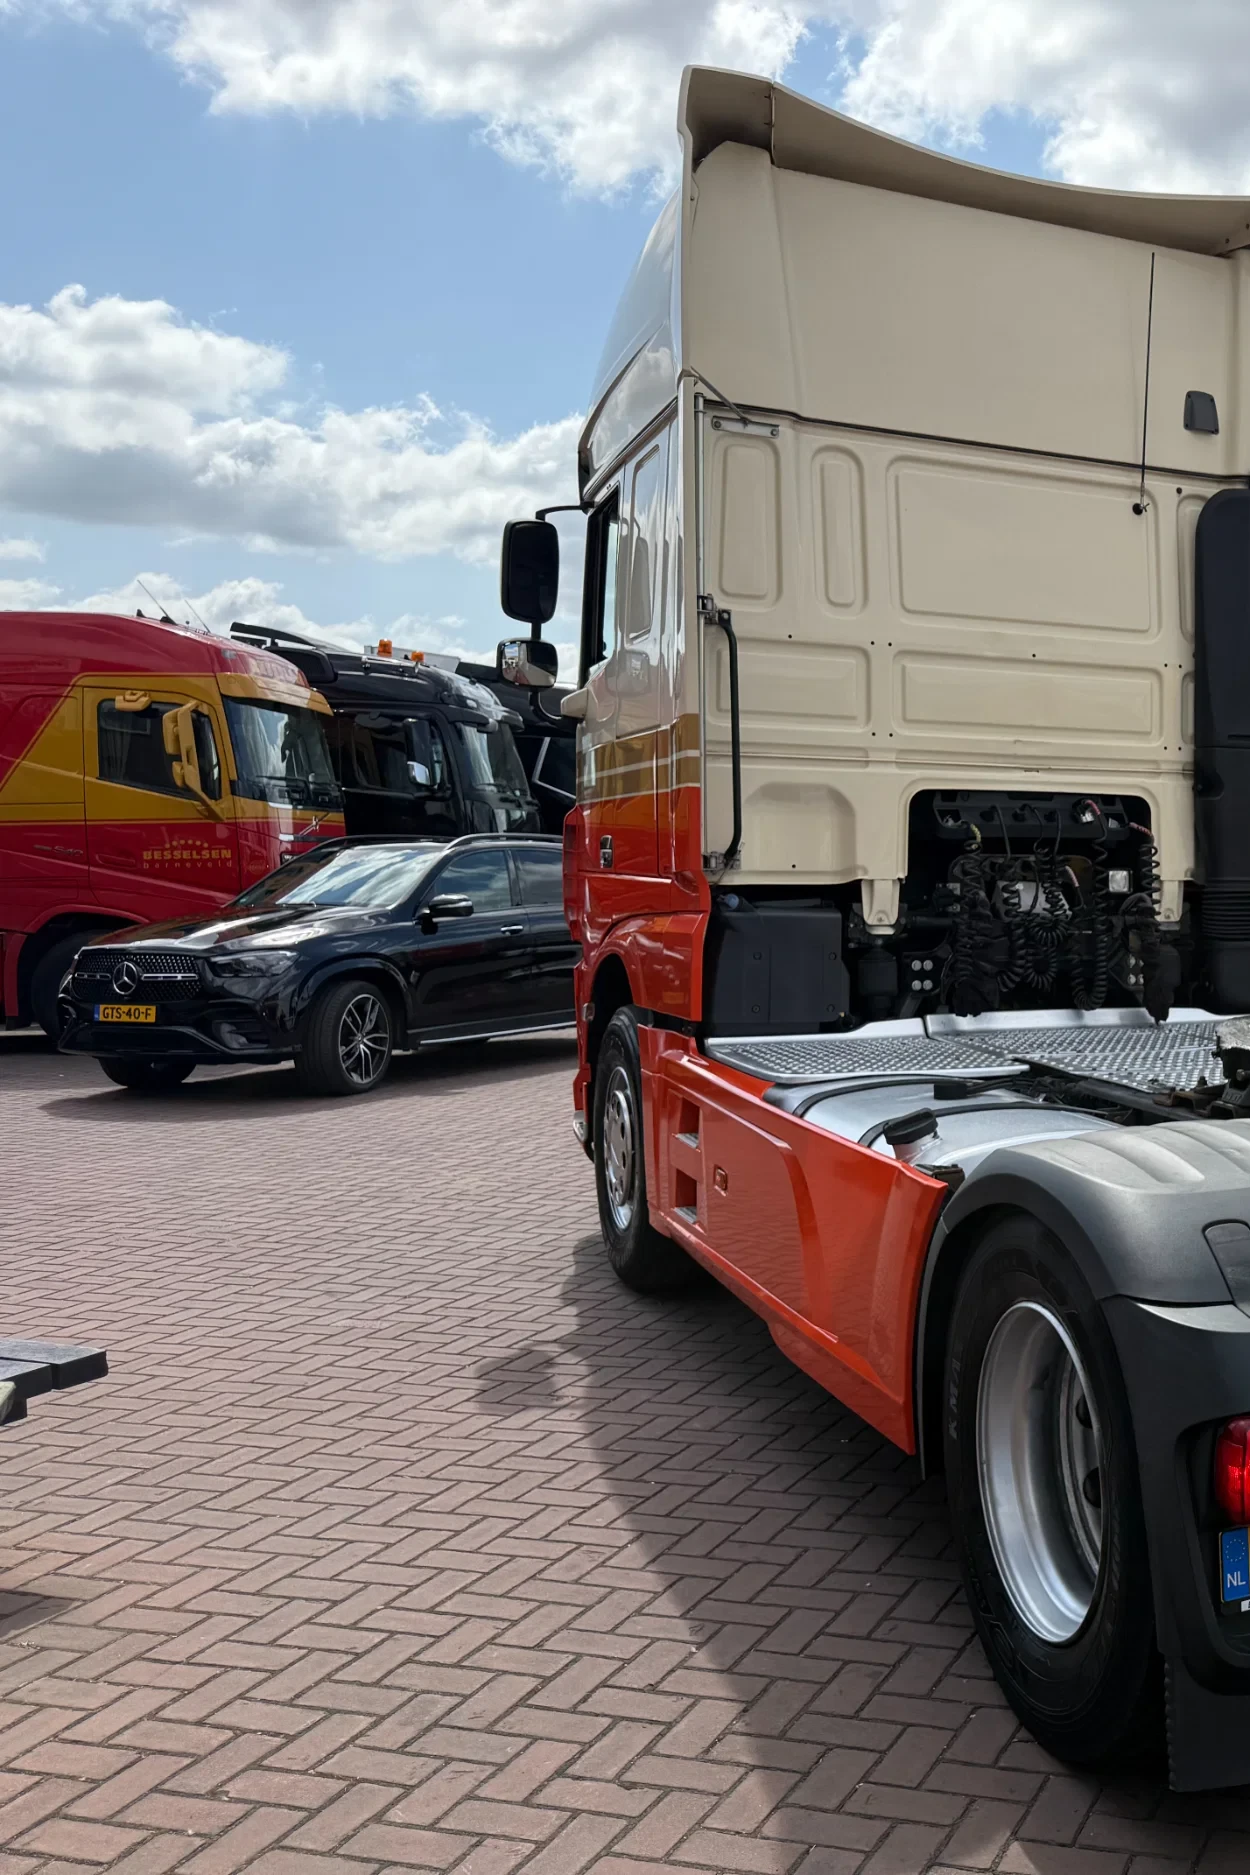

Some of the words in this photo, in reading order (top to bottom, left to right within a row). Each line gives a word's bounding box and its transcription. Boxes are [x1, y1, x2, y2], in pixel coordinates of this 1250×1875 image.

[143, 849, 232, 860] BESSELSEN
[143, 860, 232, 869] barneveld
[102, 1006, 153, 1021] GTS-40-F
[1227, 1571, 1247, 1588] NL
